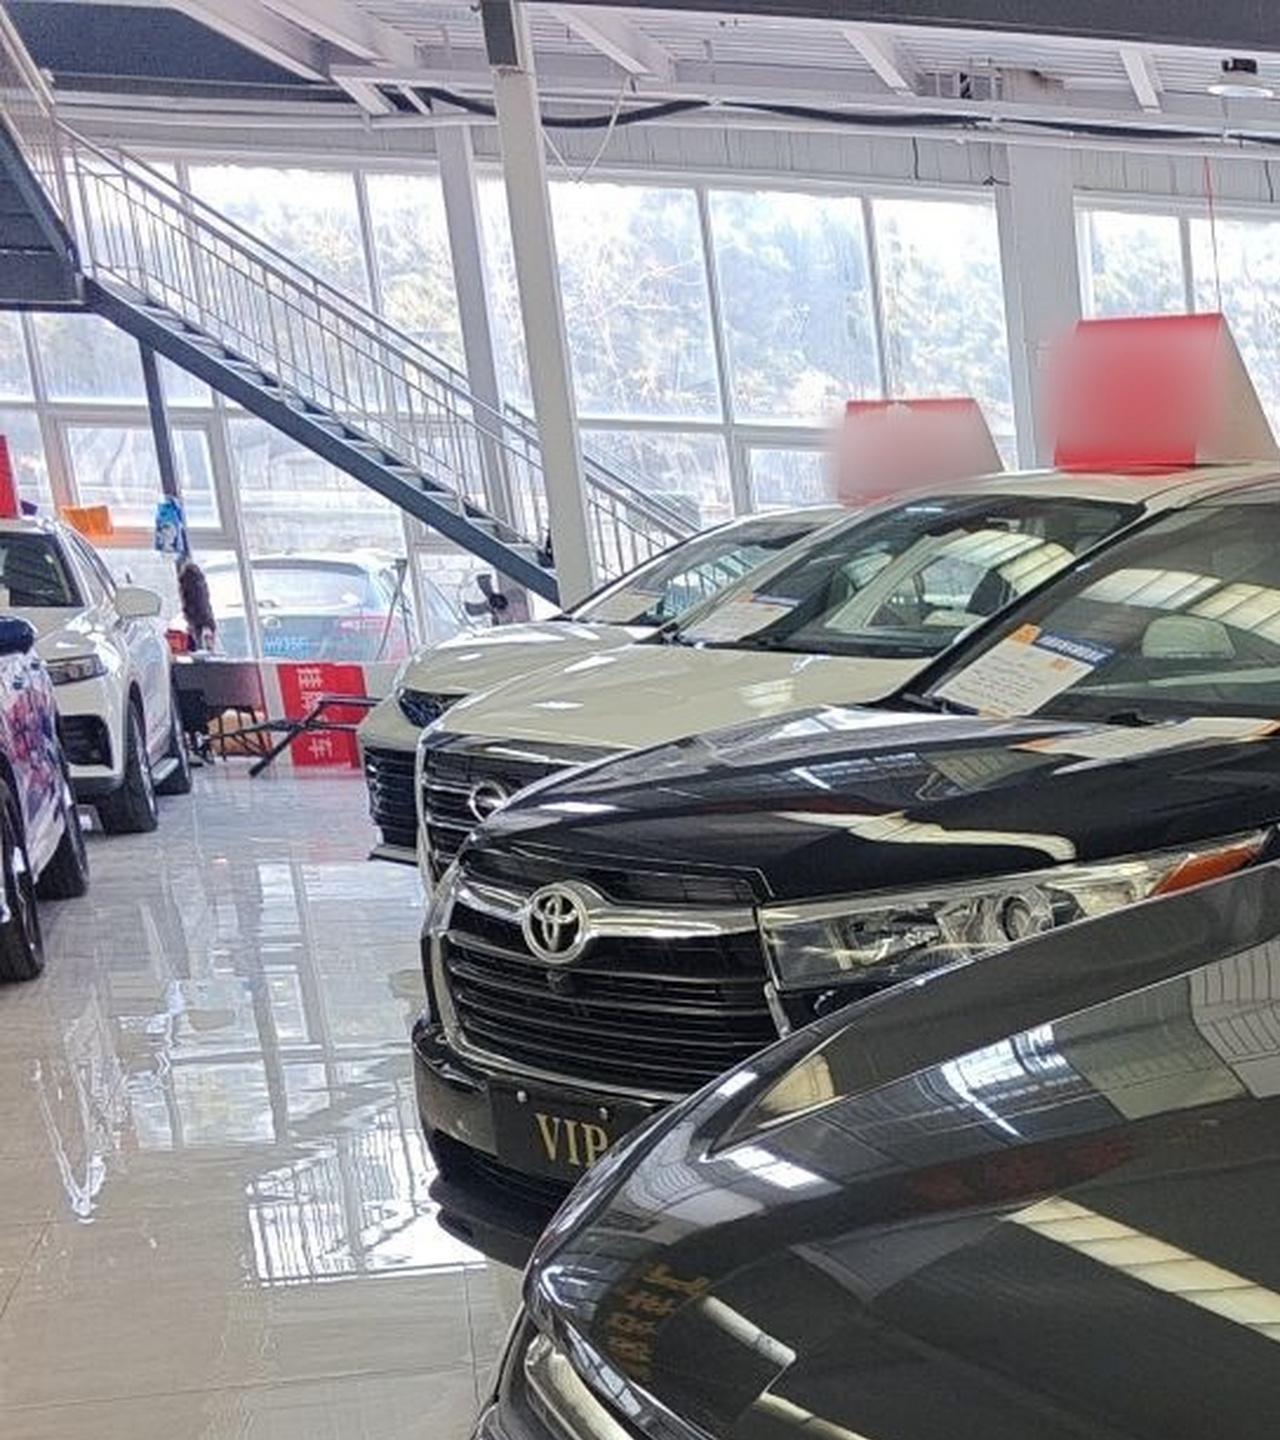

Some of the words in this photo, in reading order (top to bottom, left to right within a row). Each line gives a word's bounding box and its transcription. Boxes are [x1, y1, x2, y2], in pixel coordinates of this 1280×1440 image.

[297, 667, 333, 759] 挂牌车
[533, 1112, 609, 1168] VIP
